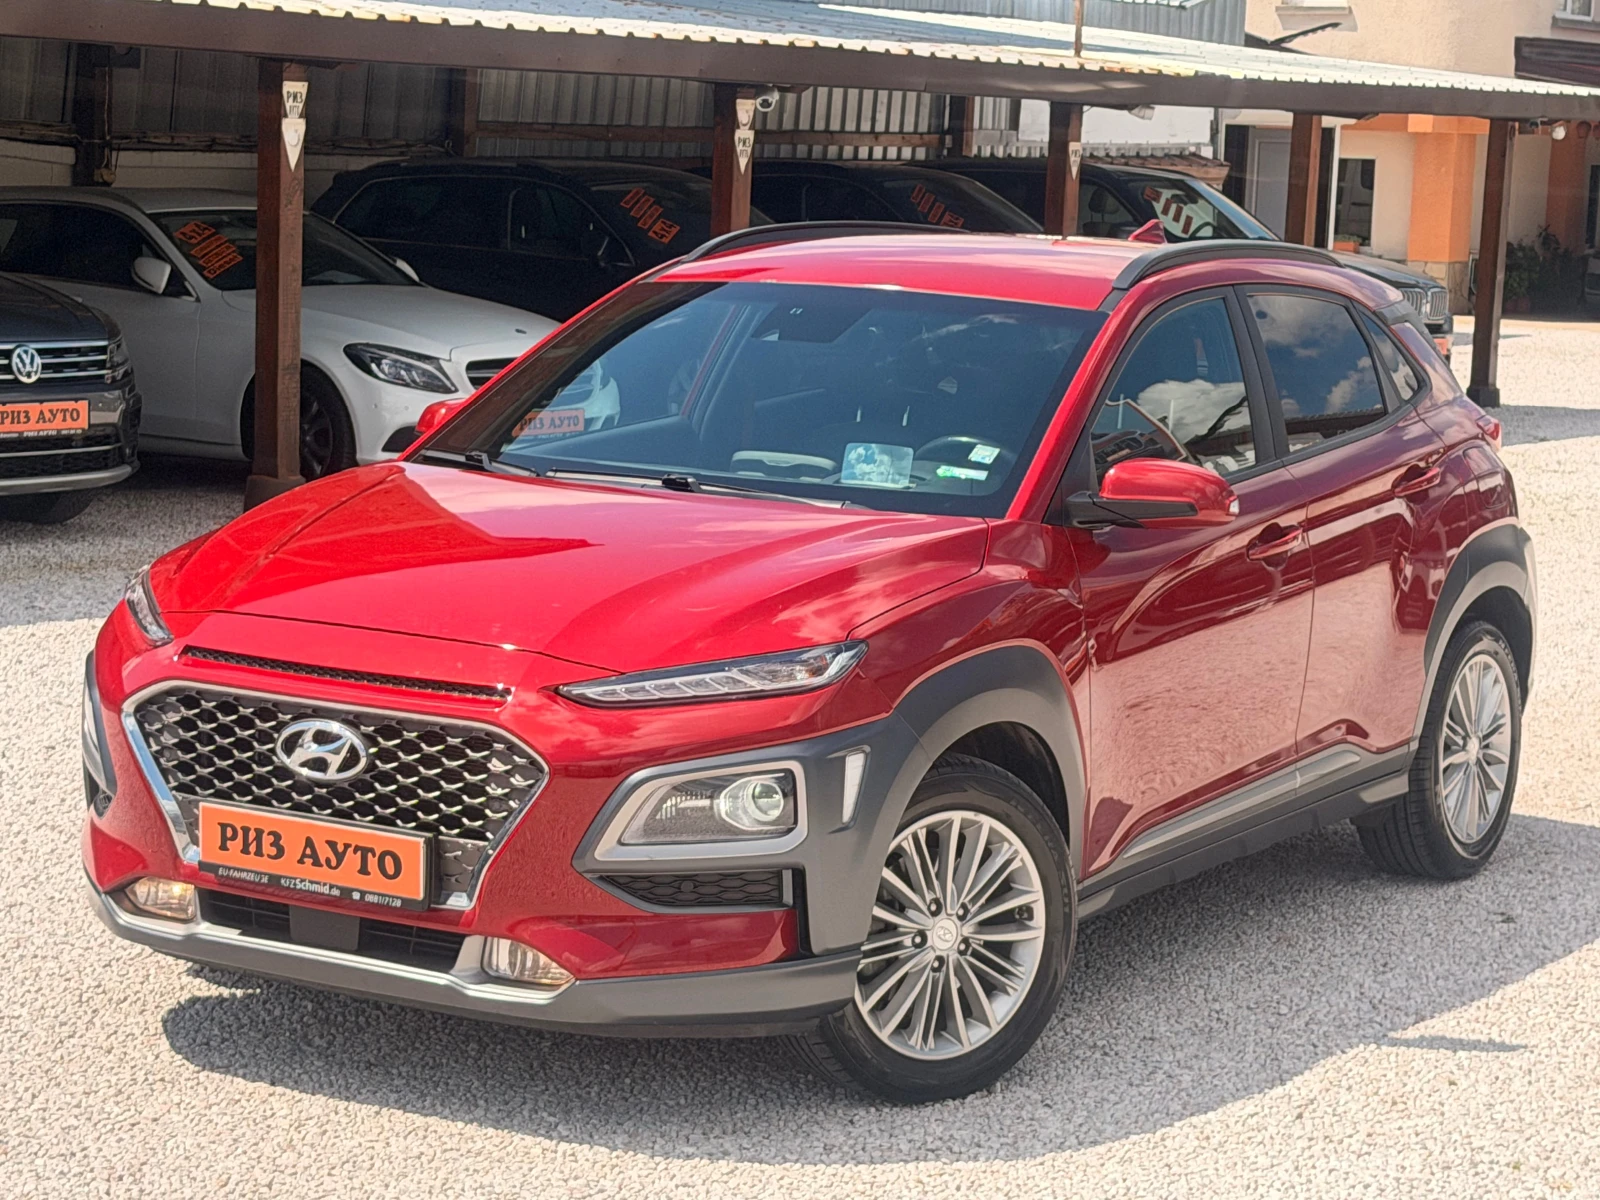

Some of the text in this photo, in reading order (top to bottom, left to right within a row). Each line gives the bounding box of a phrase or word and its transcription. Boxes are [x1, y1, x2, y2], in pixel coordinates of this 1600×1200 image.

[286, 91, 304, 104] РИЗ
[0, 407, 80, 425] РИЗ АУТО
[548, 415, 580, 429] АУТО
[217, 822, 402, 880] РИЗ АУТО
